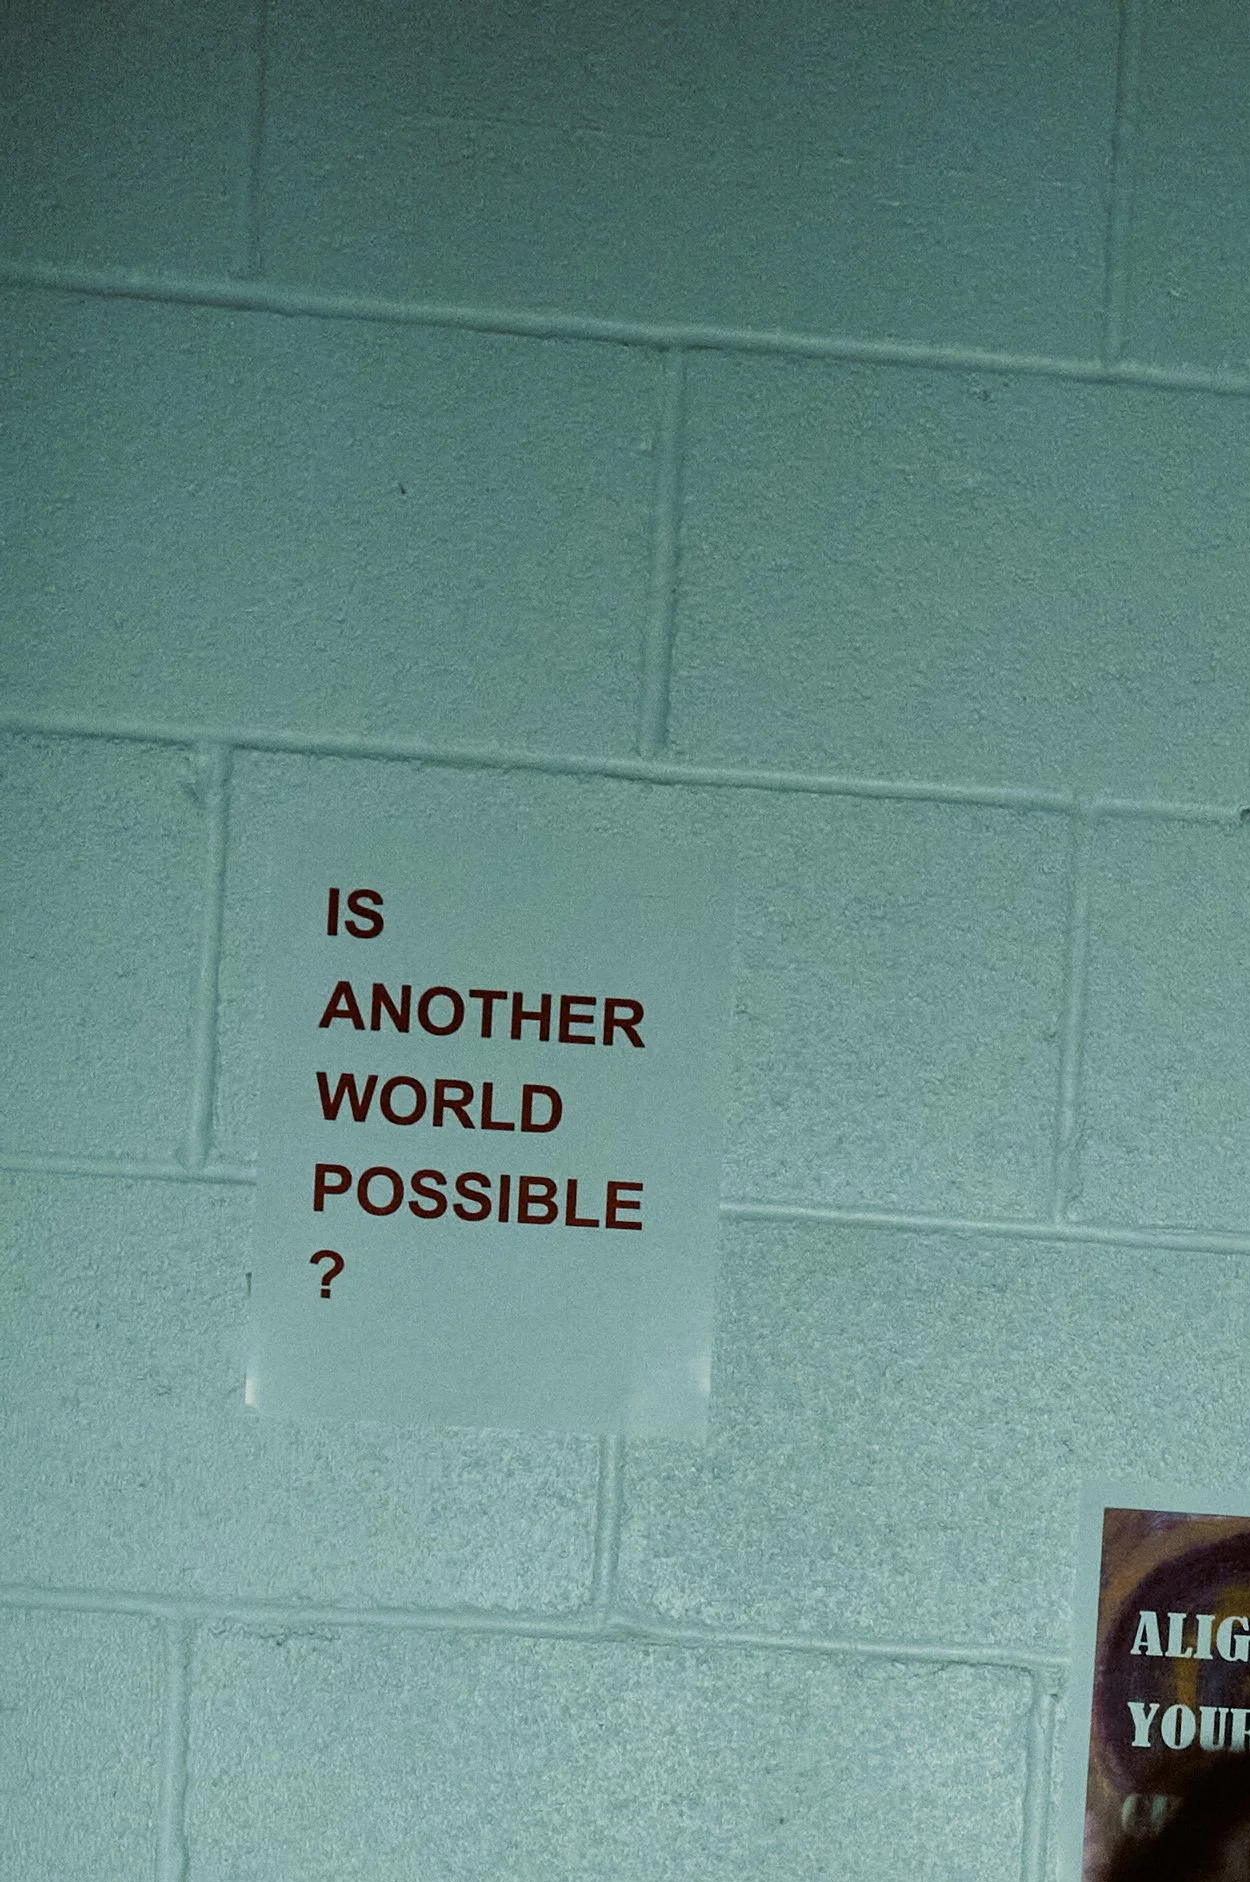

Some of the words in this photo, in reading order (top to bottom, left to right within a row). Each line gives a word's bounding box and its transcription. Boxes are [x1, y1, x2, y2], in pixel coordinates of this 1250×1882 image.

[326, 887, 385, 939] IS
[318, 980, 646, 1049] ANOTHER
[315, 1070, 563, 1134] WORLD
[312, 1162, 645, 1231] POSSIBLE
[309, 1249, 346, 1299] ?
